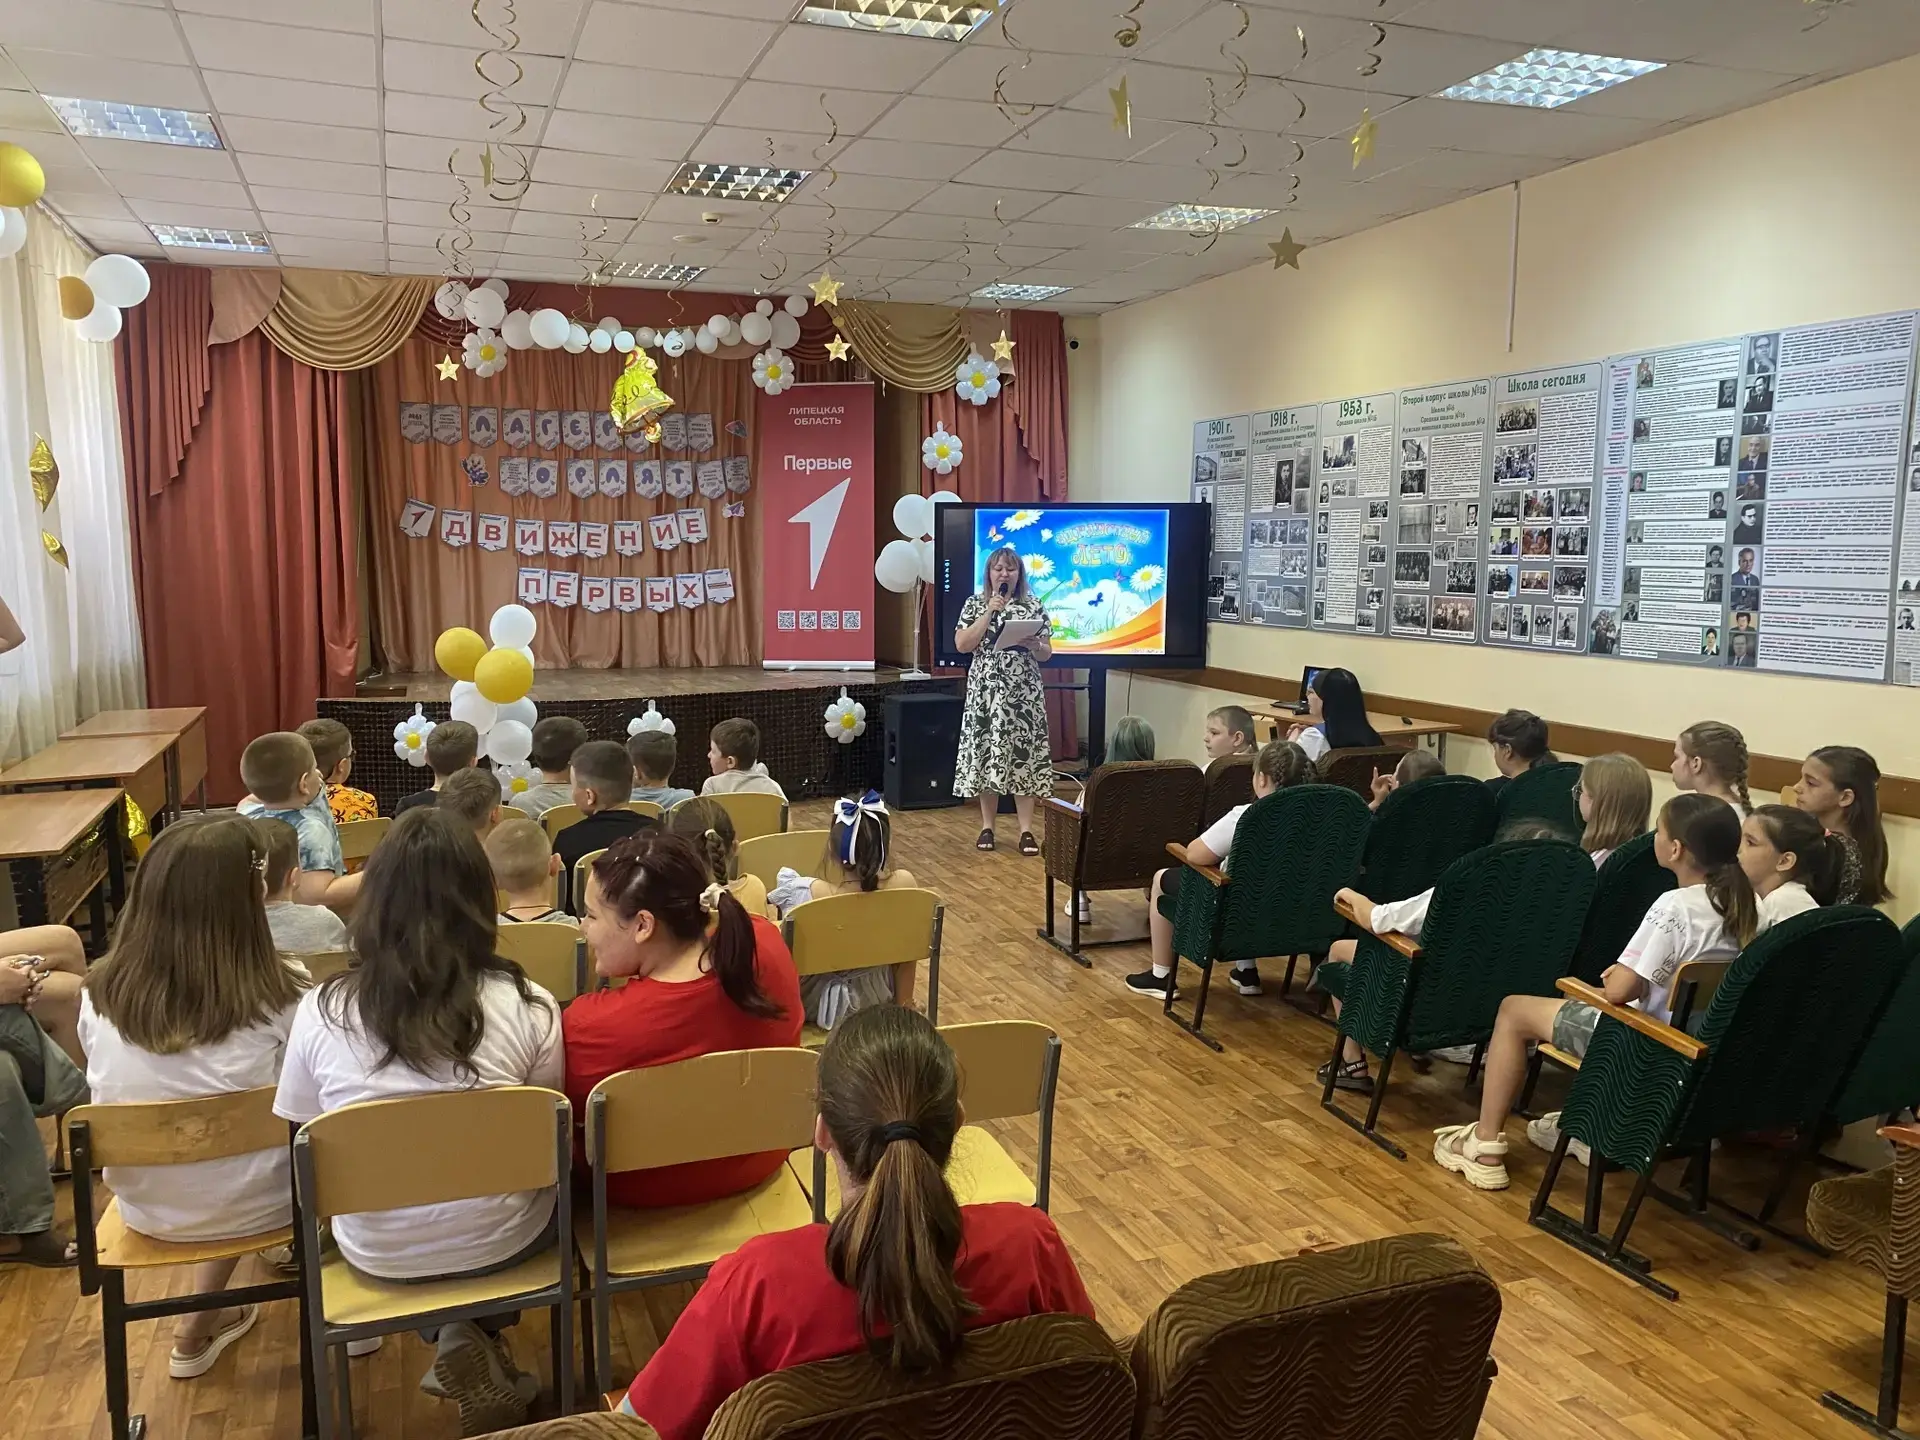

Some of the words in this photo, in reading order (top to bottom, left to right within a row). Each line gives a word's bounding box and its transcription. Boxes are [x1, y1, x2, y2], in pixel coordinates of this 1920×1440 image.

[1508, 379, 1539, 393] Школа
[1542, 373, 1586, 388] сегодня
[1402, 394, 1424, 405] Второй
[1425, 393, 1446, 403] корпус
[788, 406, 844, 415] ЛИПЕЦКАЯ
[1340, 400, 1363, 418] 1953
[1366, 403, 1374, 414] г.
[794, 417, 842, 425] ОБЛАСТЬ
[1209, 421, 1224, 435] 1901
[1270, 411, 1288, 427] 1918
[784, 455, 852, 475] Первые
[536, 466, 685, 485] ОРЛЯТ
[445, 518, 702, 548] ДВИЖЕНИЕ
[524, 577, 698, 603] ПЕРВЫХ
